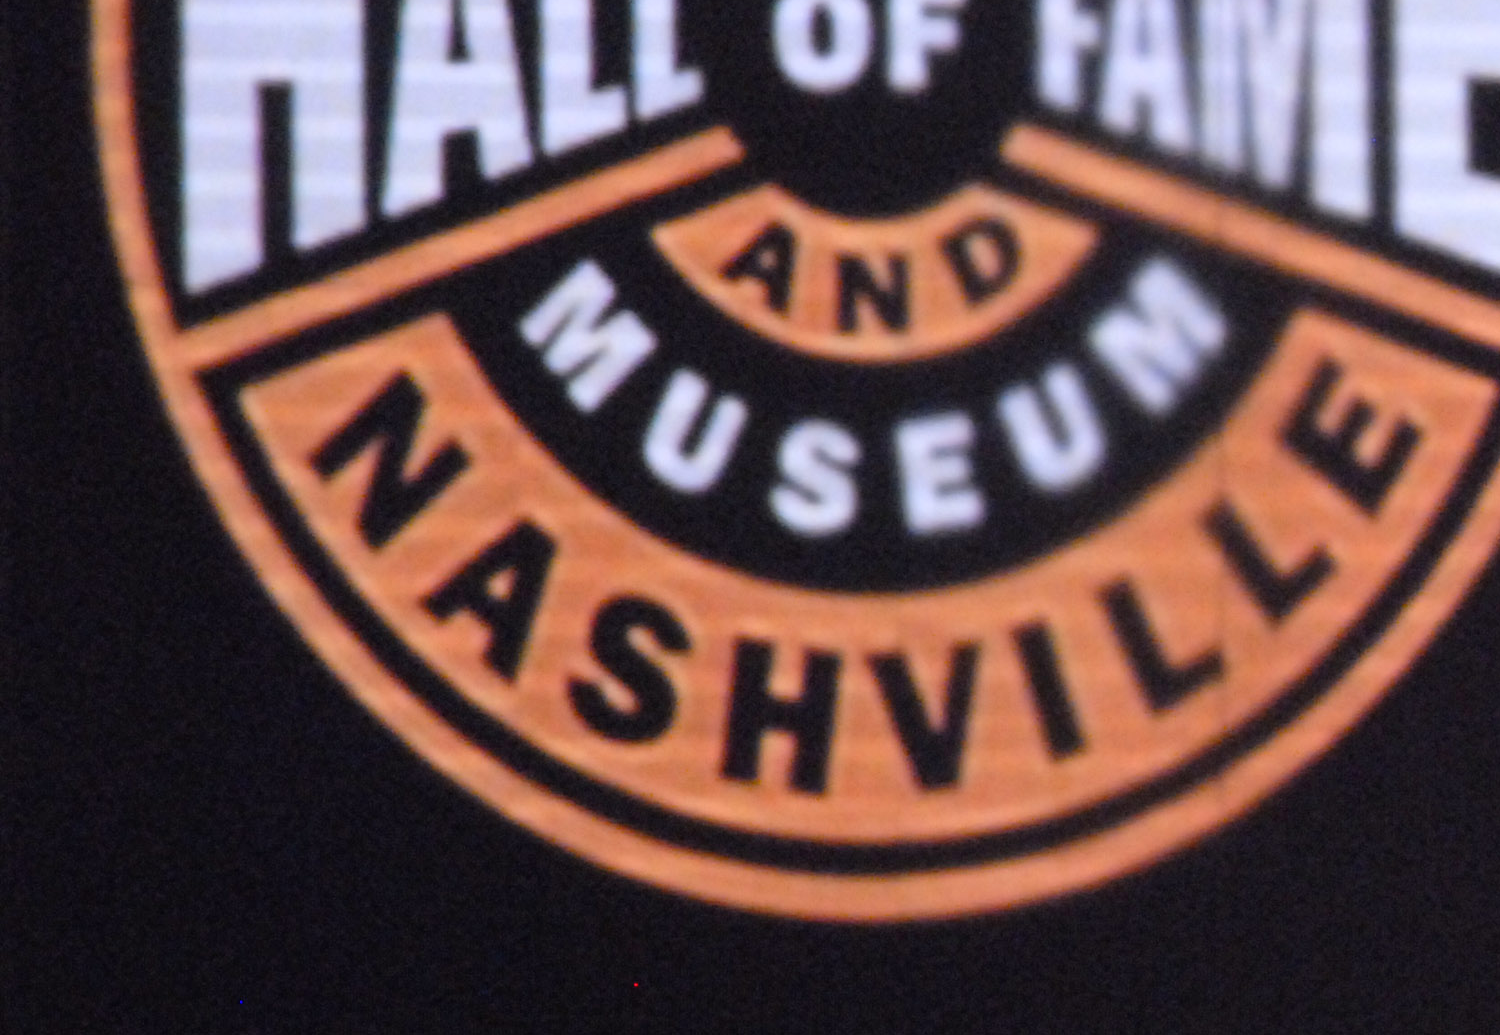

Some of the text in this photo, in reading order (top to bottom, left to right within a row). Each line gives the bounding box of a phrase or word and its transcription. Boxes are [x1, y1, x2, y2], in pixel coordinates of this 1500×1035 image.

[520, 257, 1228, 537] MUSEUM
[722, 217, 1018, 334] AND
[311, 355, 1424, 795] NASHVILLE
